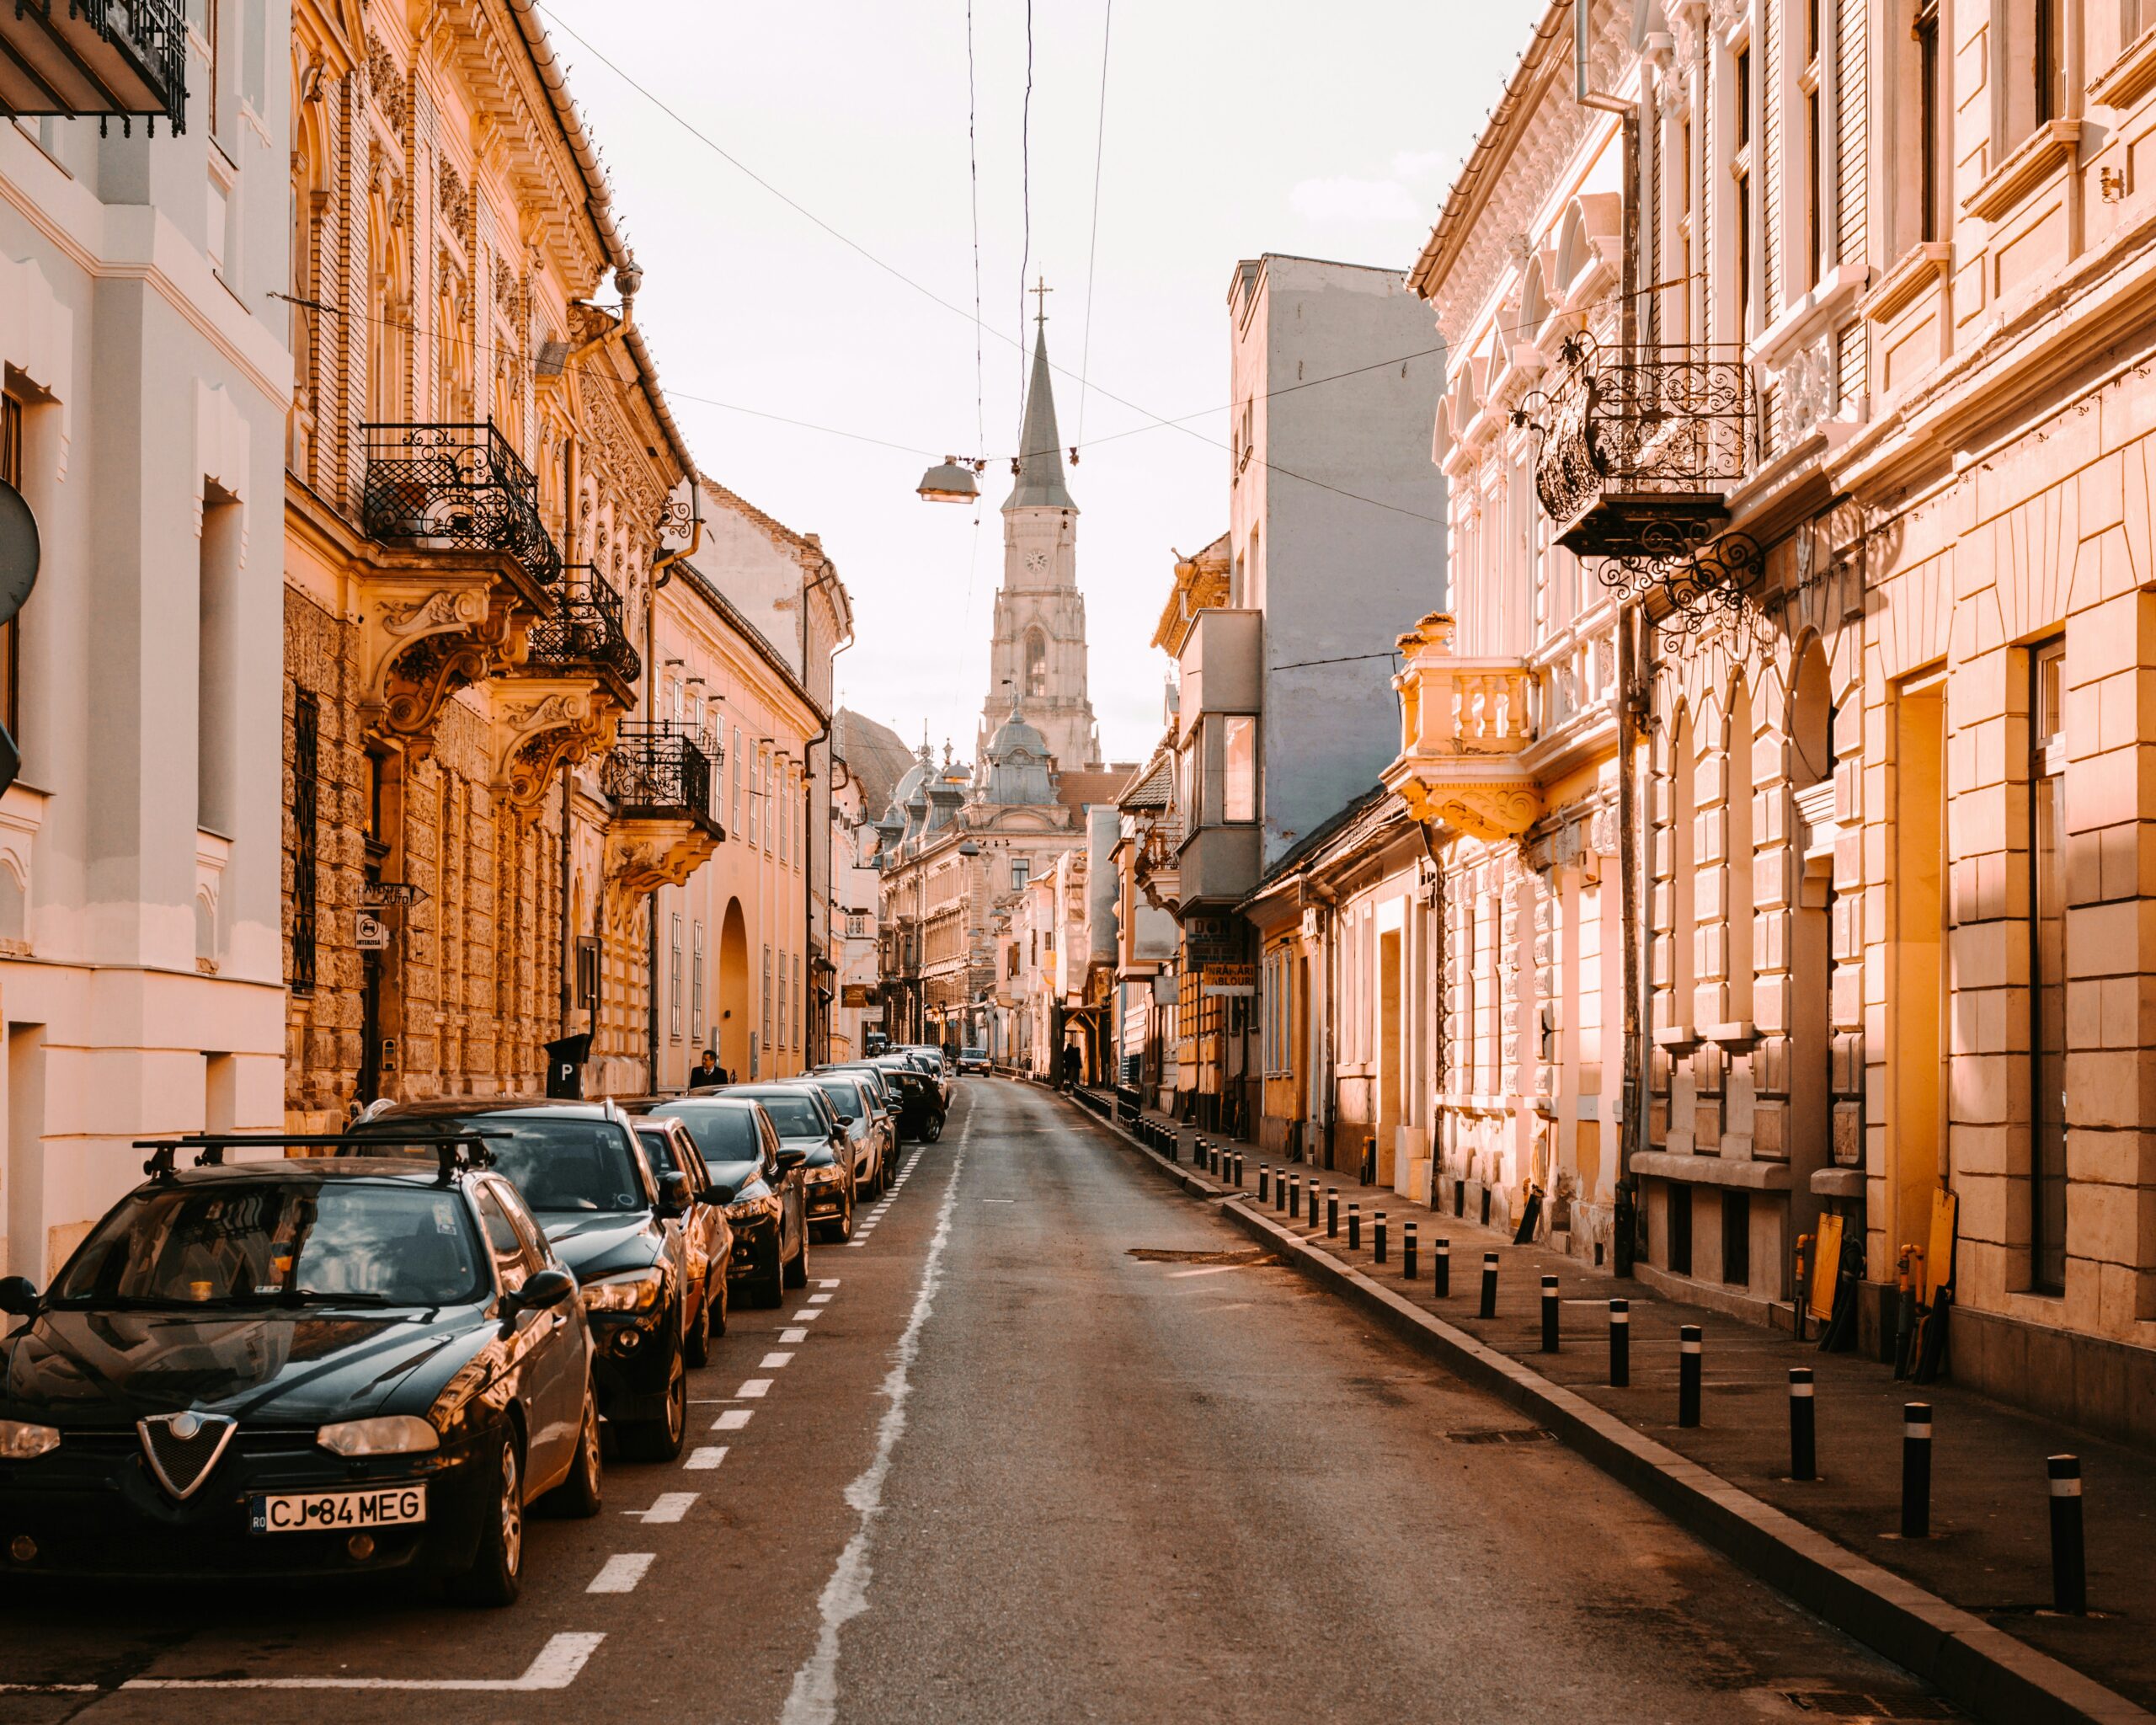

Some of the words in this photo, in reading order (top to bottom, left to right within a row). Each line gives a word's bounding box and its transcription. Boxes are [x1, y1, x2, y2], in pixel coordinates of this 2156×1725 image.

[382, 895, 408, 905] AUTO
[562, 1064, 573, 1081] P
[270, 1499, 307, 1527] CJ
[319, 1498, 353, 1525] 84
[359, 1492, 419, 1523] MEG
[253, 1516, 266, 1528] RO
